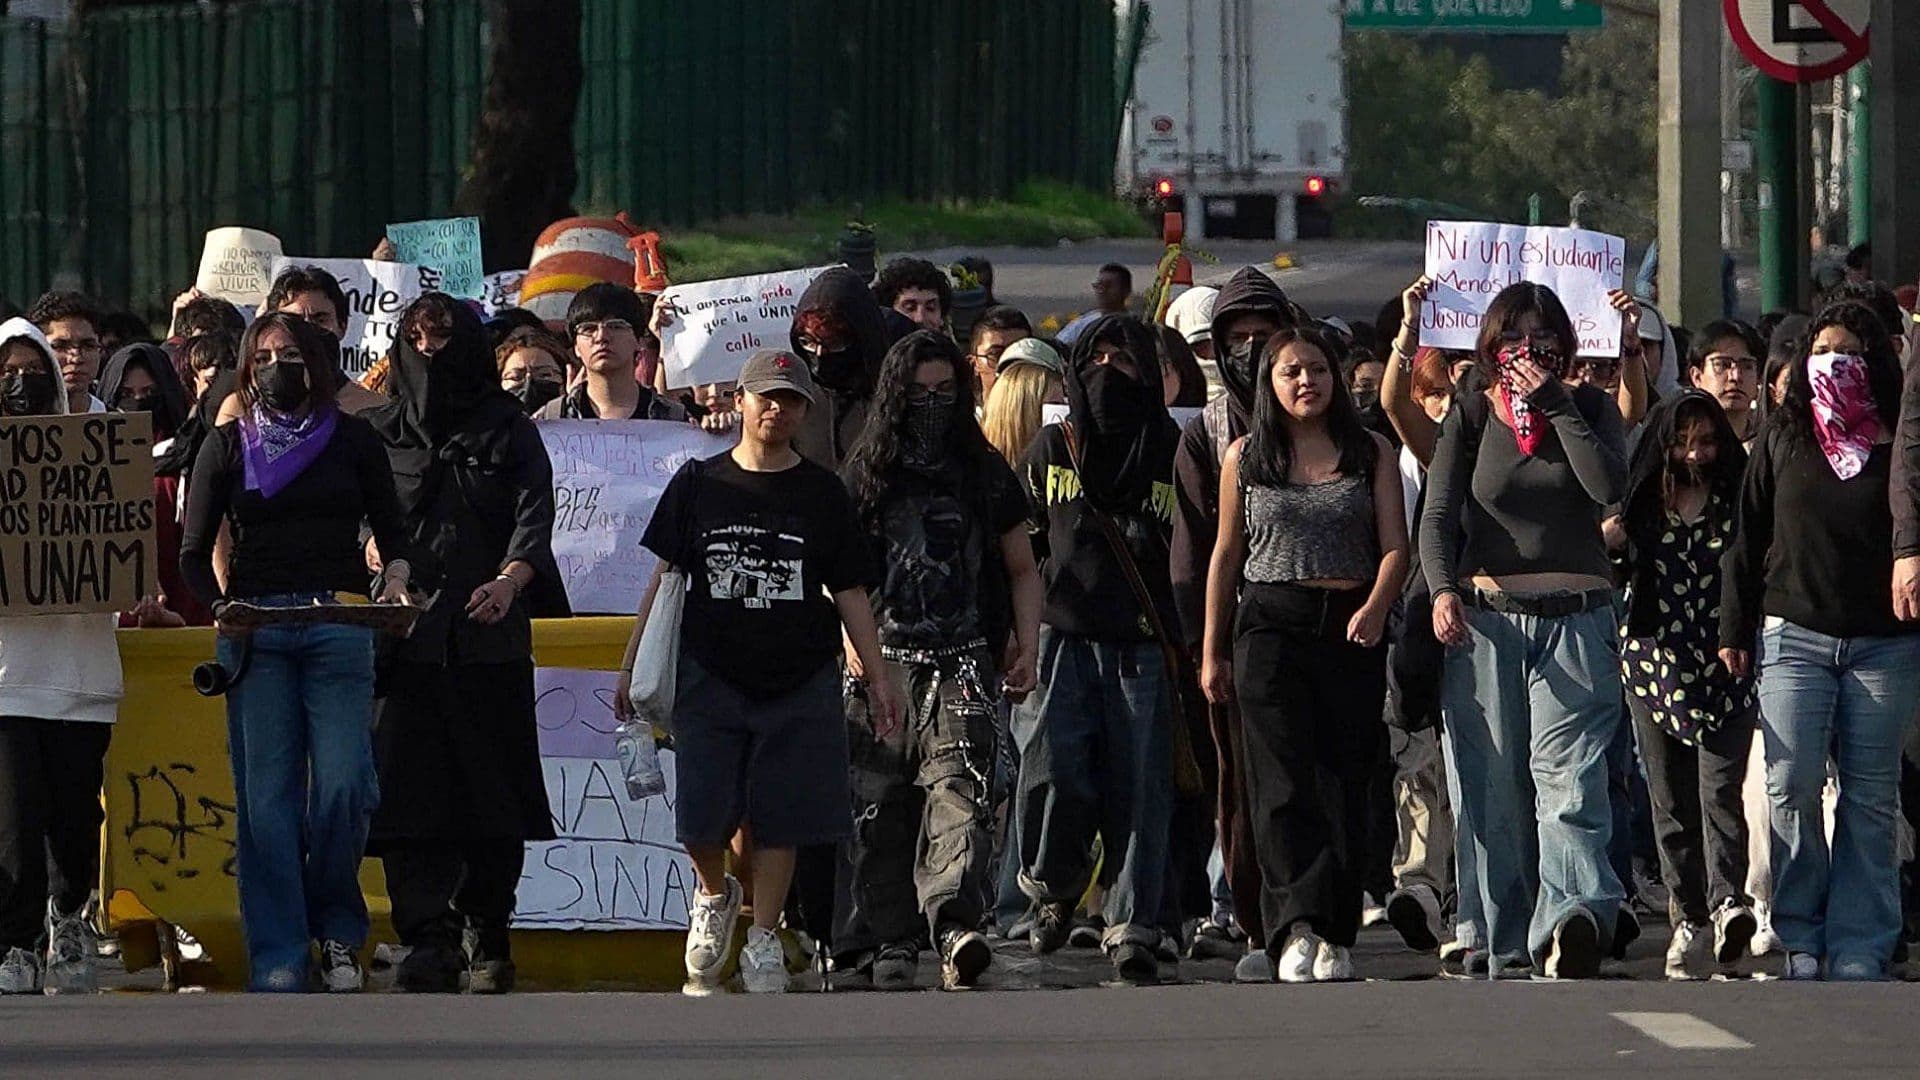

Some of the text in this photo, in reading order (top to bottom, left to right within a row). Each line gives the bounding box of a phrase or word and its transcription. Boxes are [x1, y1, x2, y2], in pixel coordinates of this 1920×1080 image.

[1480, 238, 1511, 265] un
[1518, 233, 1622, 276] estudiante
[667, 283, 793, 319] Tu ausencia grita
[736, 310, 748, 324] la
[41, 464, 114, 503] PARA
[38, 499, 154, 537] PLANTELES
[24, 538, 145, 607] UNAM
